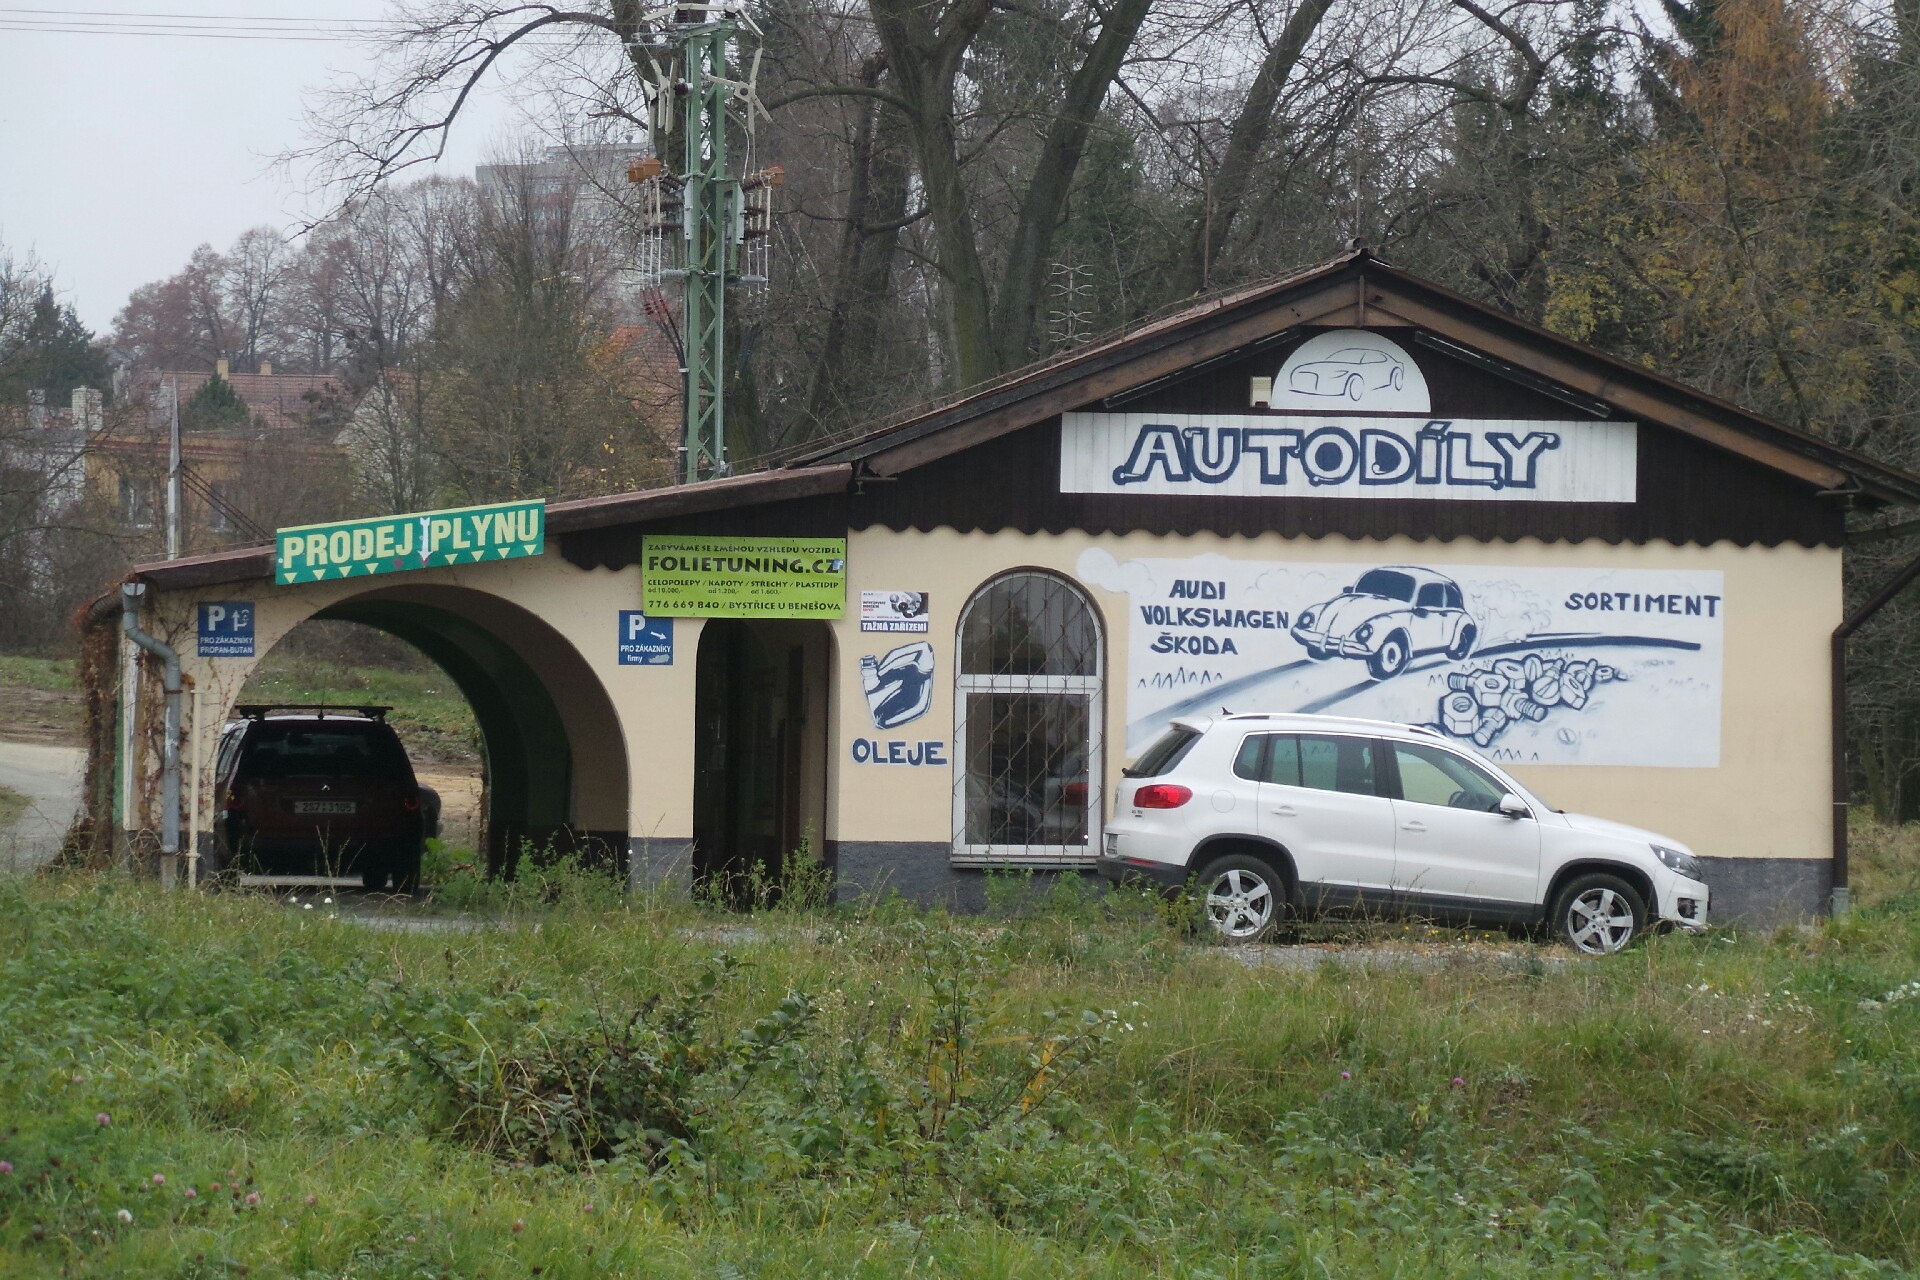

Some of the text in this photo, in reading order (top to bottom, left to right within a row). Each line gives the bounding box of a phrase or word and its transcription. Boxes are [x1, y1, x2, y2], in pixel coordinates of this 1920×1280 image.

[1112, 420, 1560, 490] AUTODÍLY
[283, 508, 539, 569] PRODEJ PLYNU
[648, 556, 839, 574] FOLIETUNING.CZ
[1169, 579, 1226, 600] AUDI
[649, 600, 669, 609] 776
[673, 601, 694, 609] 669
[697, 601, 719, 609] 840
[729, 600, 776, 610] BYSTŘICE
[778, 602, 785, 610] U
[788, 601, 841, 610] BENEŠOVA
[1564, 592, 1721, 617] SORTIMENT
[208, 605, 226, 631] P
[629, 614, 646, 640] P
[862, 621, 927, 632] TAŽNÁ ZAŘÍZENÍ
[1140, 605, 1289, 629] VOLKSWAGEN
[635, 643, 671, 653] ZÁKAZNÍKY
[1150, 632, 1238, 656] ŠKODA
[627, 654, 643, 663] firmy
[852, 738, 947, 766] OLEJE
